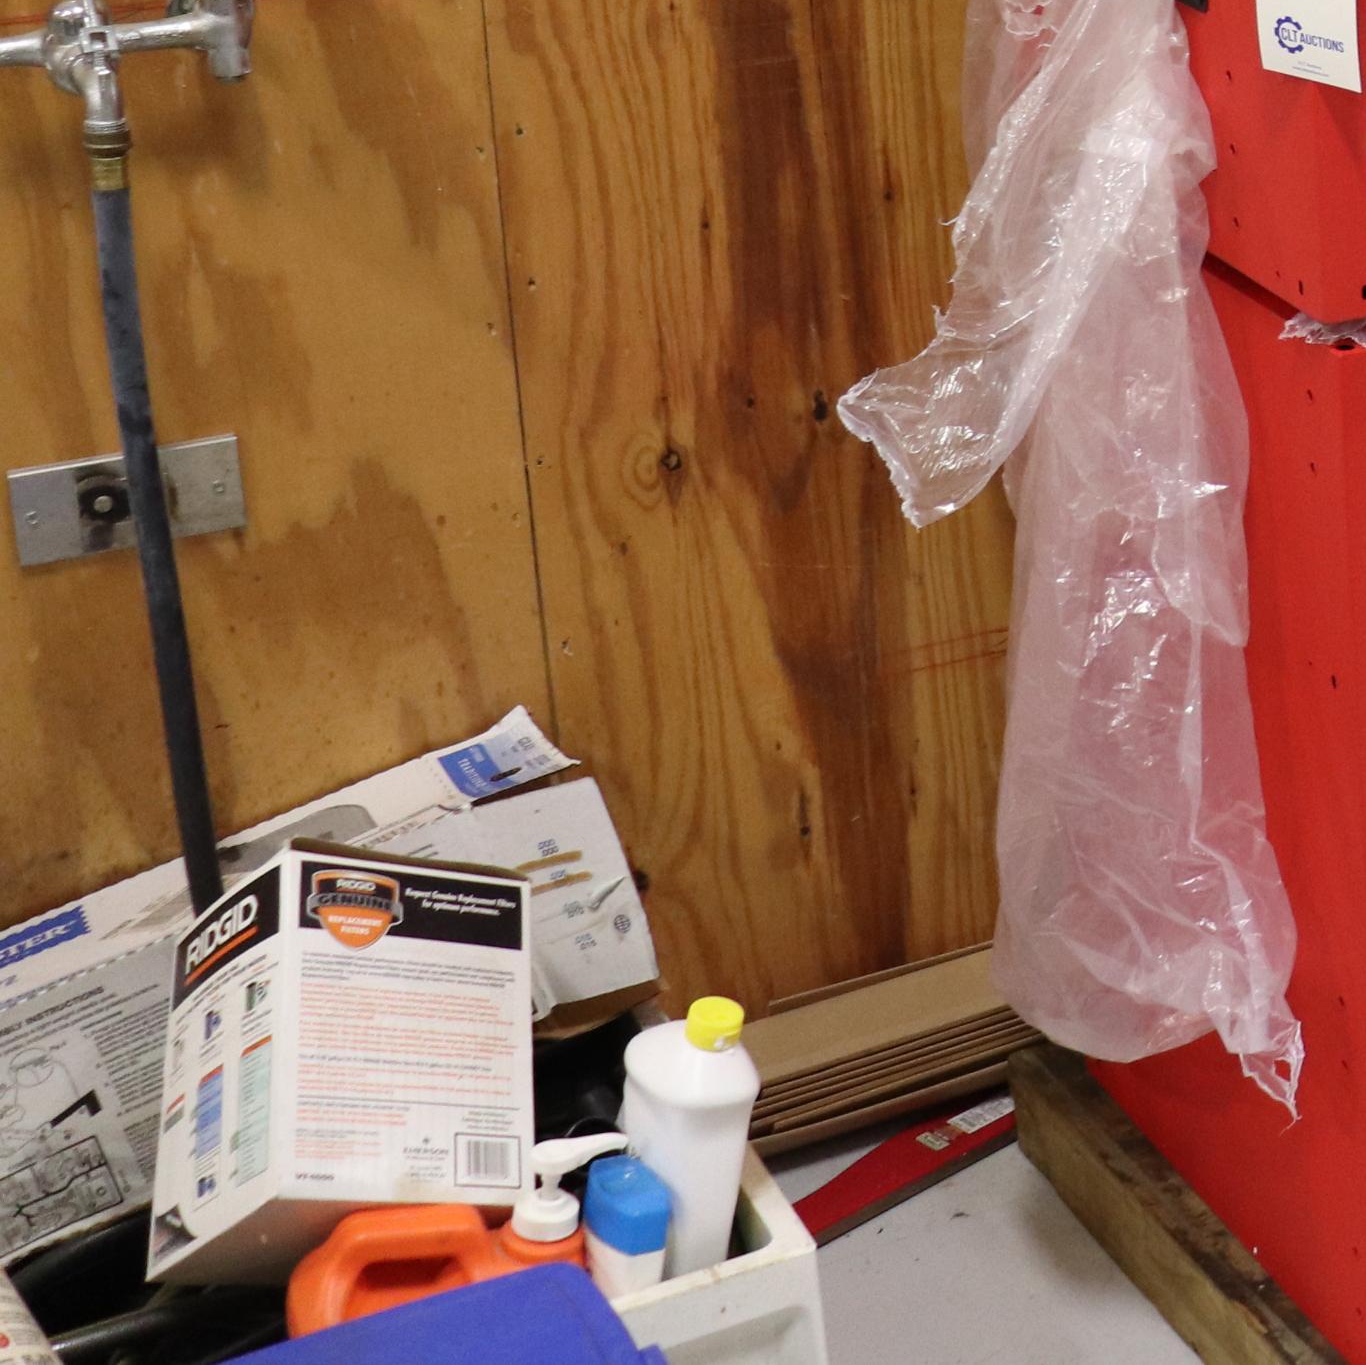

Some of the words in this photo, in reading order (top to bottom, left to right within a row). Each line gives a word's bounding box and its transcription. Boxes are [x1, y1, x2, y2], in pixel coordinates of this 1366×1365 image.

[1281, 27, 1298, 44] CLT
[1299, 32, 1345, 54] AUCTIONS
[317, 892, 393, 911] GENUINE
[184, 893, 259, 975] RIDGID
